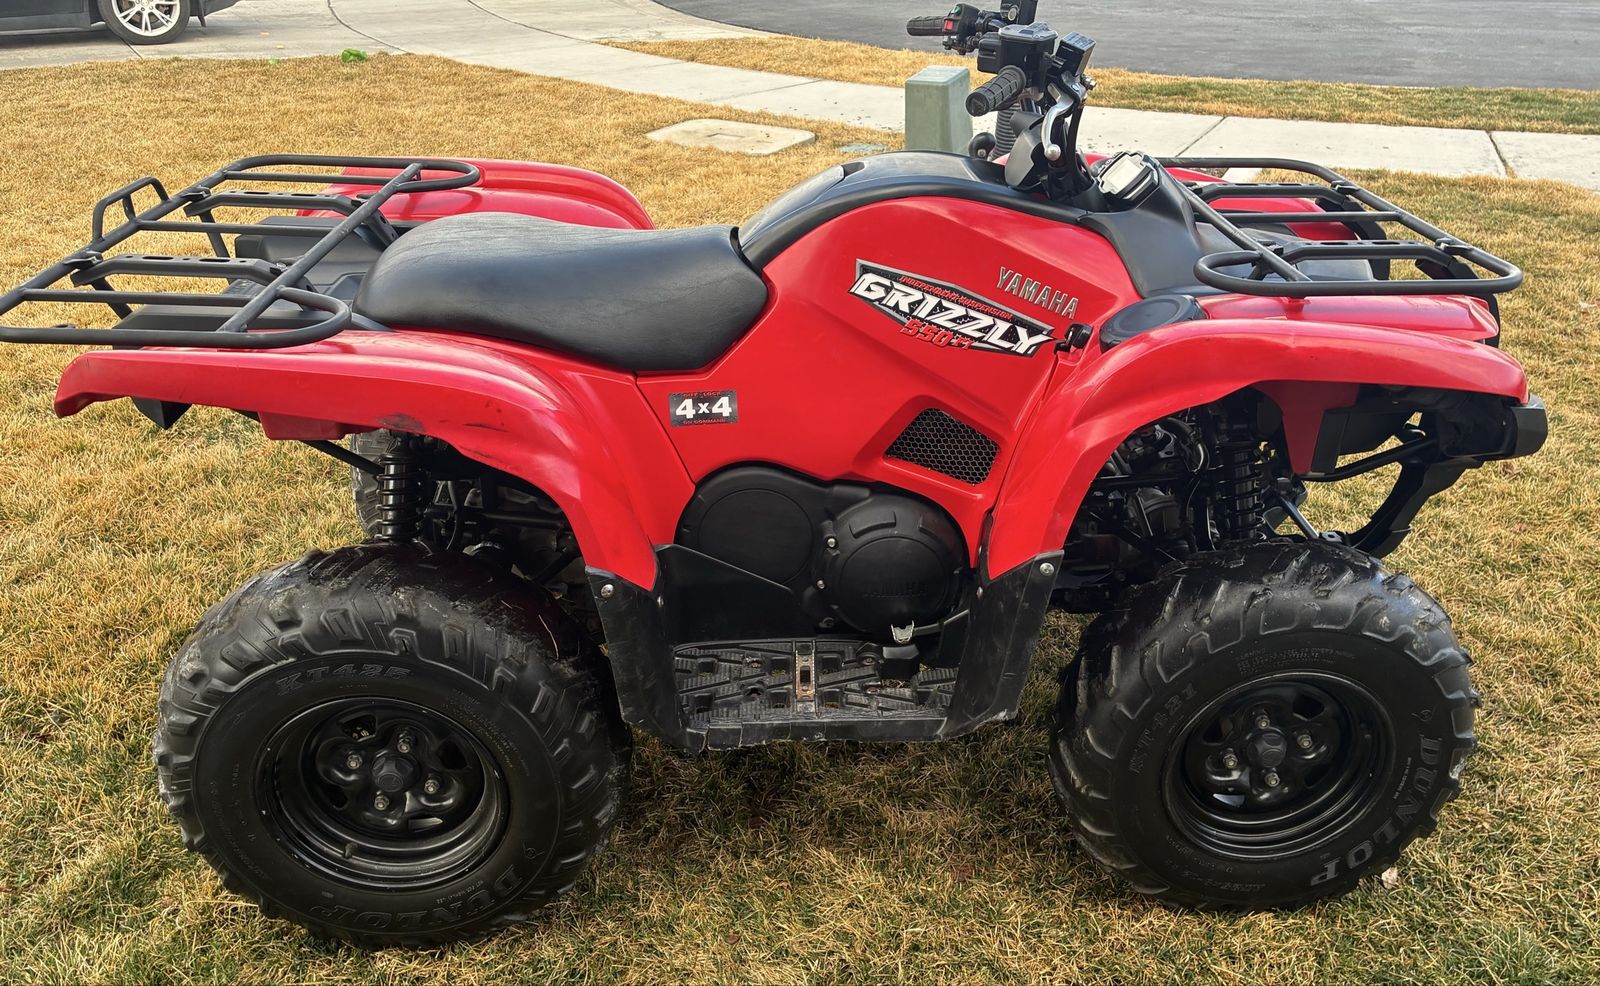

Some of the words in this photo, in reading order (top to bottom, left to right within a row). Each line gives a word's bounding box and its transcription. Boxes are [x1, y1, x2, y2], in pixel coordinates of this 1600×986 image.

[849, 272, 1054, 354] GRIZZLY
[997, 267, 1079, 319] YAMAHA
[901, 319, 954, 347] 550
[675, 396, 733, 419] 4x4
[1309, 734, 1443, 888] DUNLOP
[308, 863, 523, 929] DUNLOP
